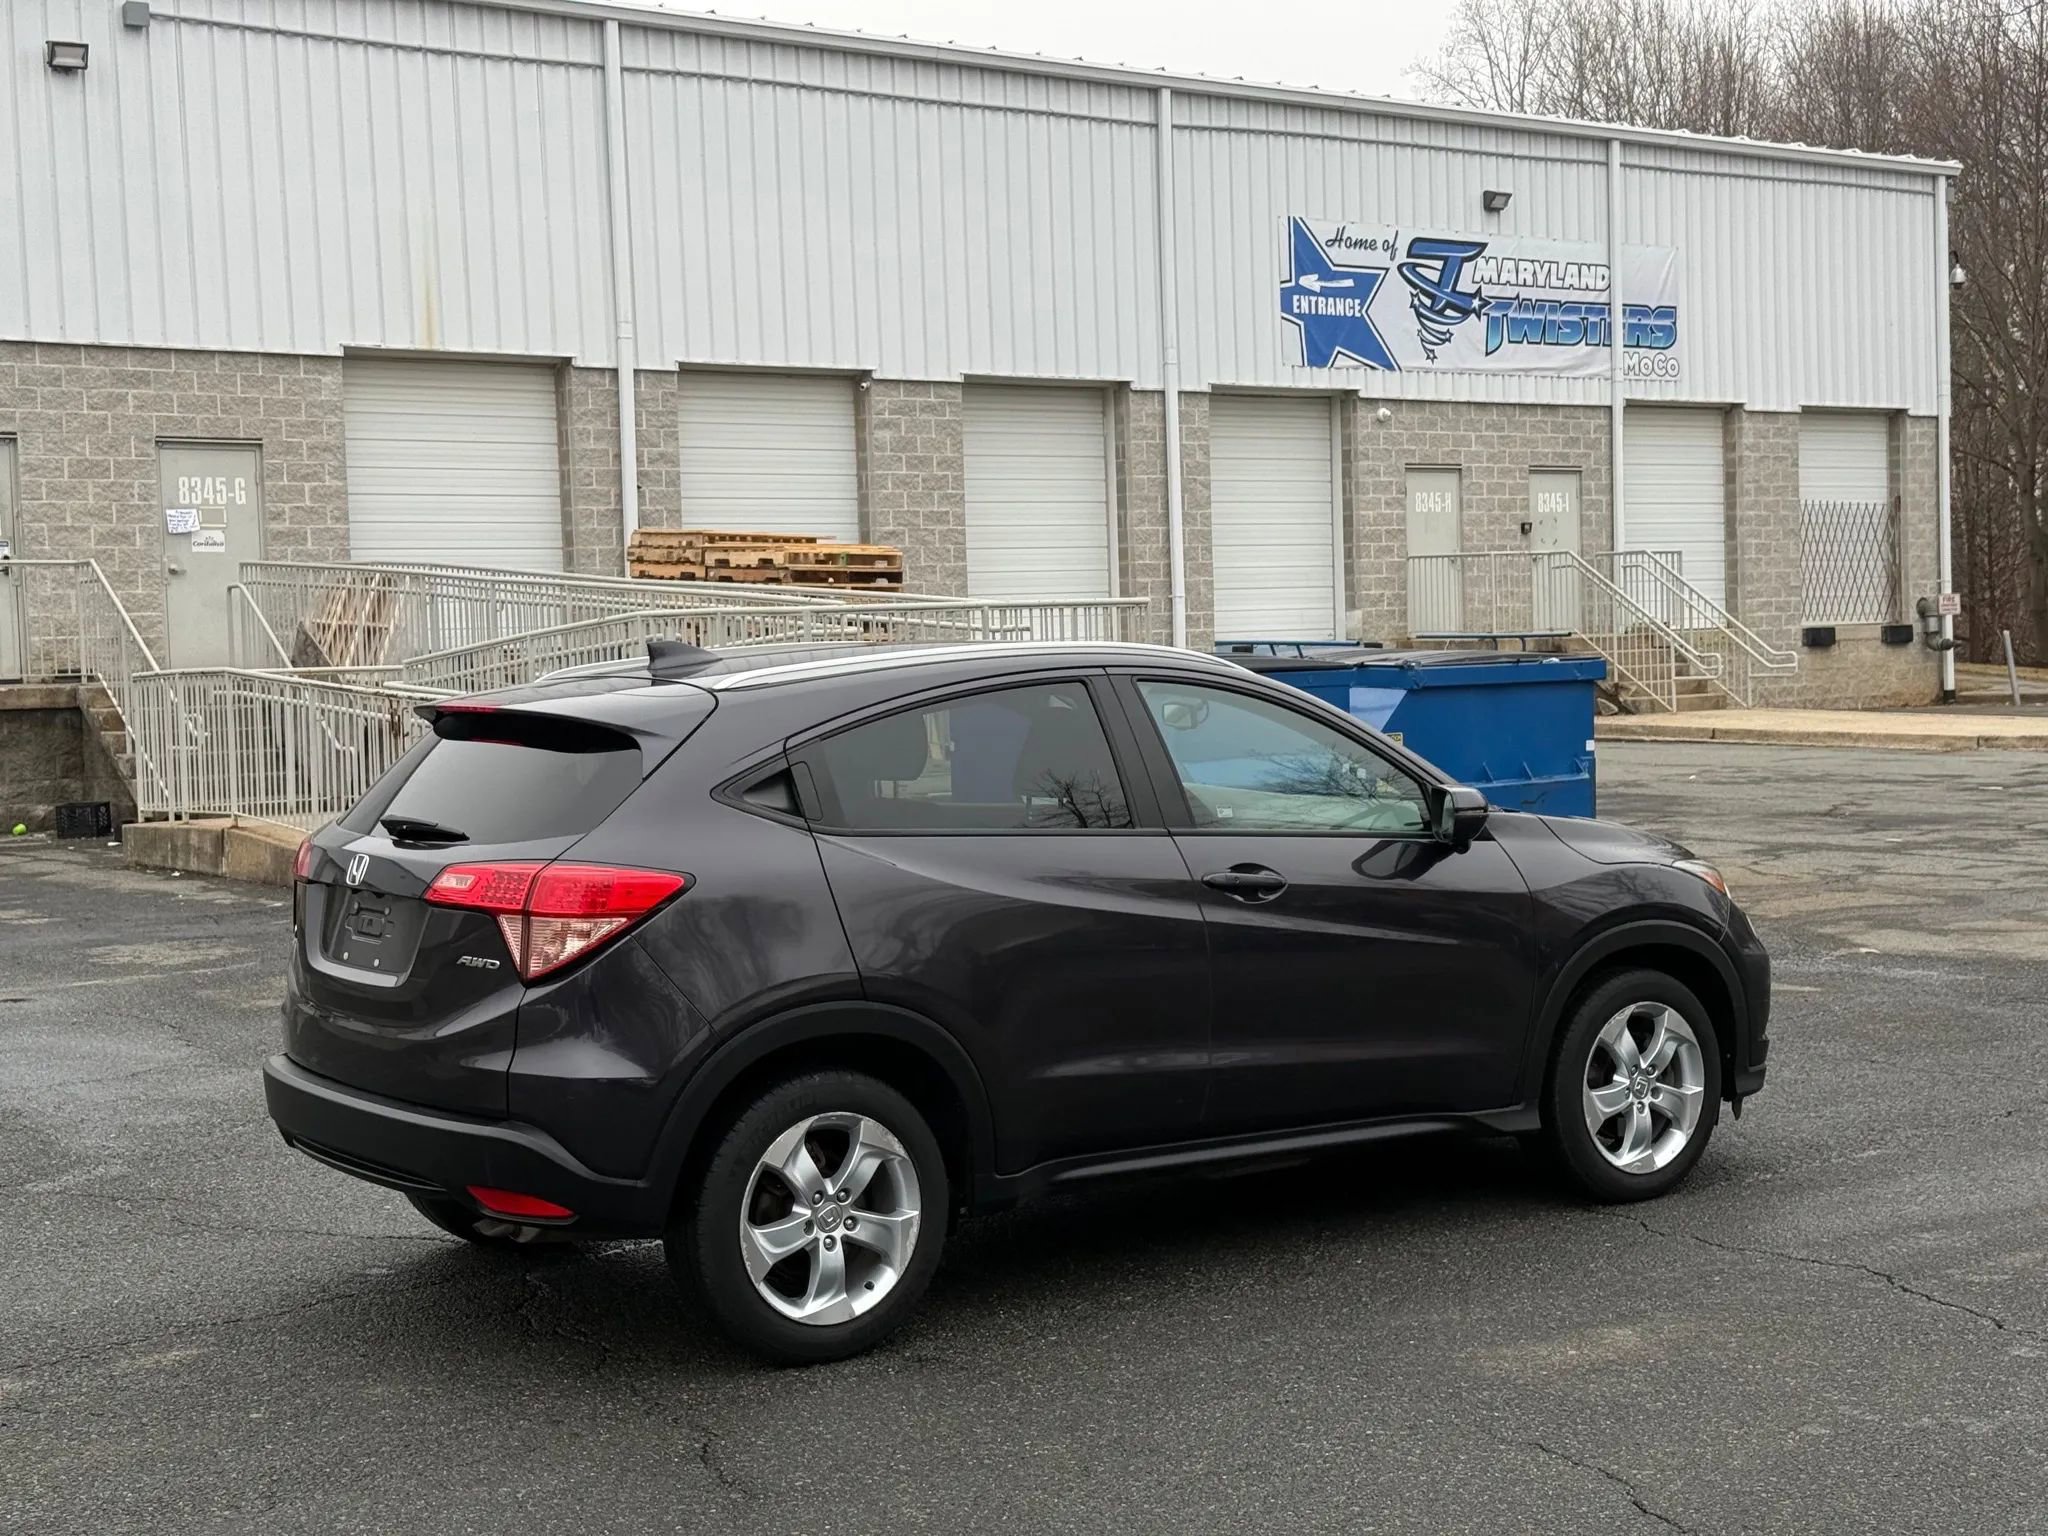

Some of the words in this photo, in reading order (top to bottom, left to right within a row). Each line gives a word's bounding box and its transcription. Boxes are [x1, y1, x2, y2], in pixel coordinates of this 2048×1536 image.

[1325, 225, 1378, 251] Home
[1382, 229, 1398, 261] of
[1472, 256, 1611, 292] MARYLAND
[1292, 294, 1362, 317] ENTRANCE
[1623, 351, 1680, 378] MoCo
[178, 476, 247, 505] 8345-G
[1415, 492, 1452, 513] 8345-H
[1537, 492, 1569, 513] 8345-I
[456, 955, 500, 970] AWD
